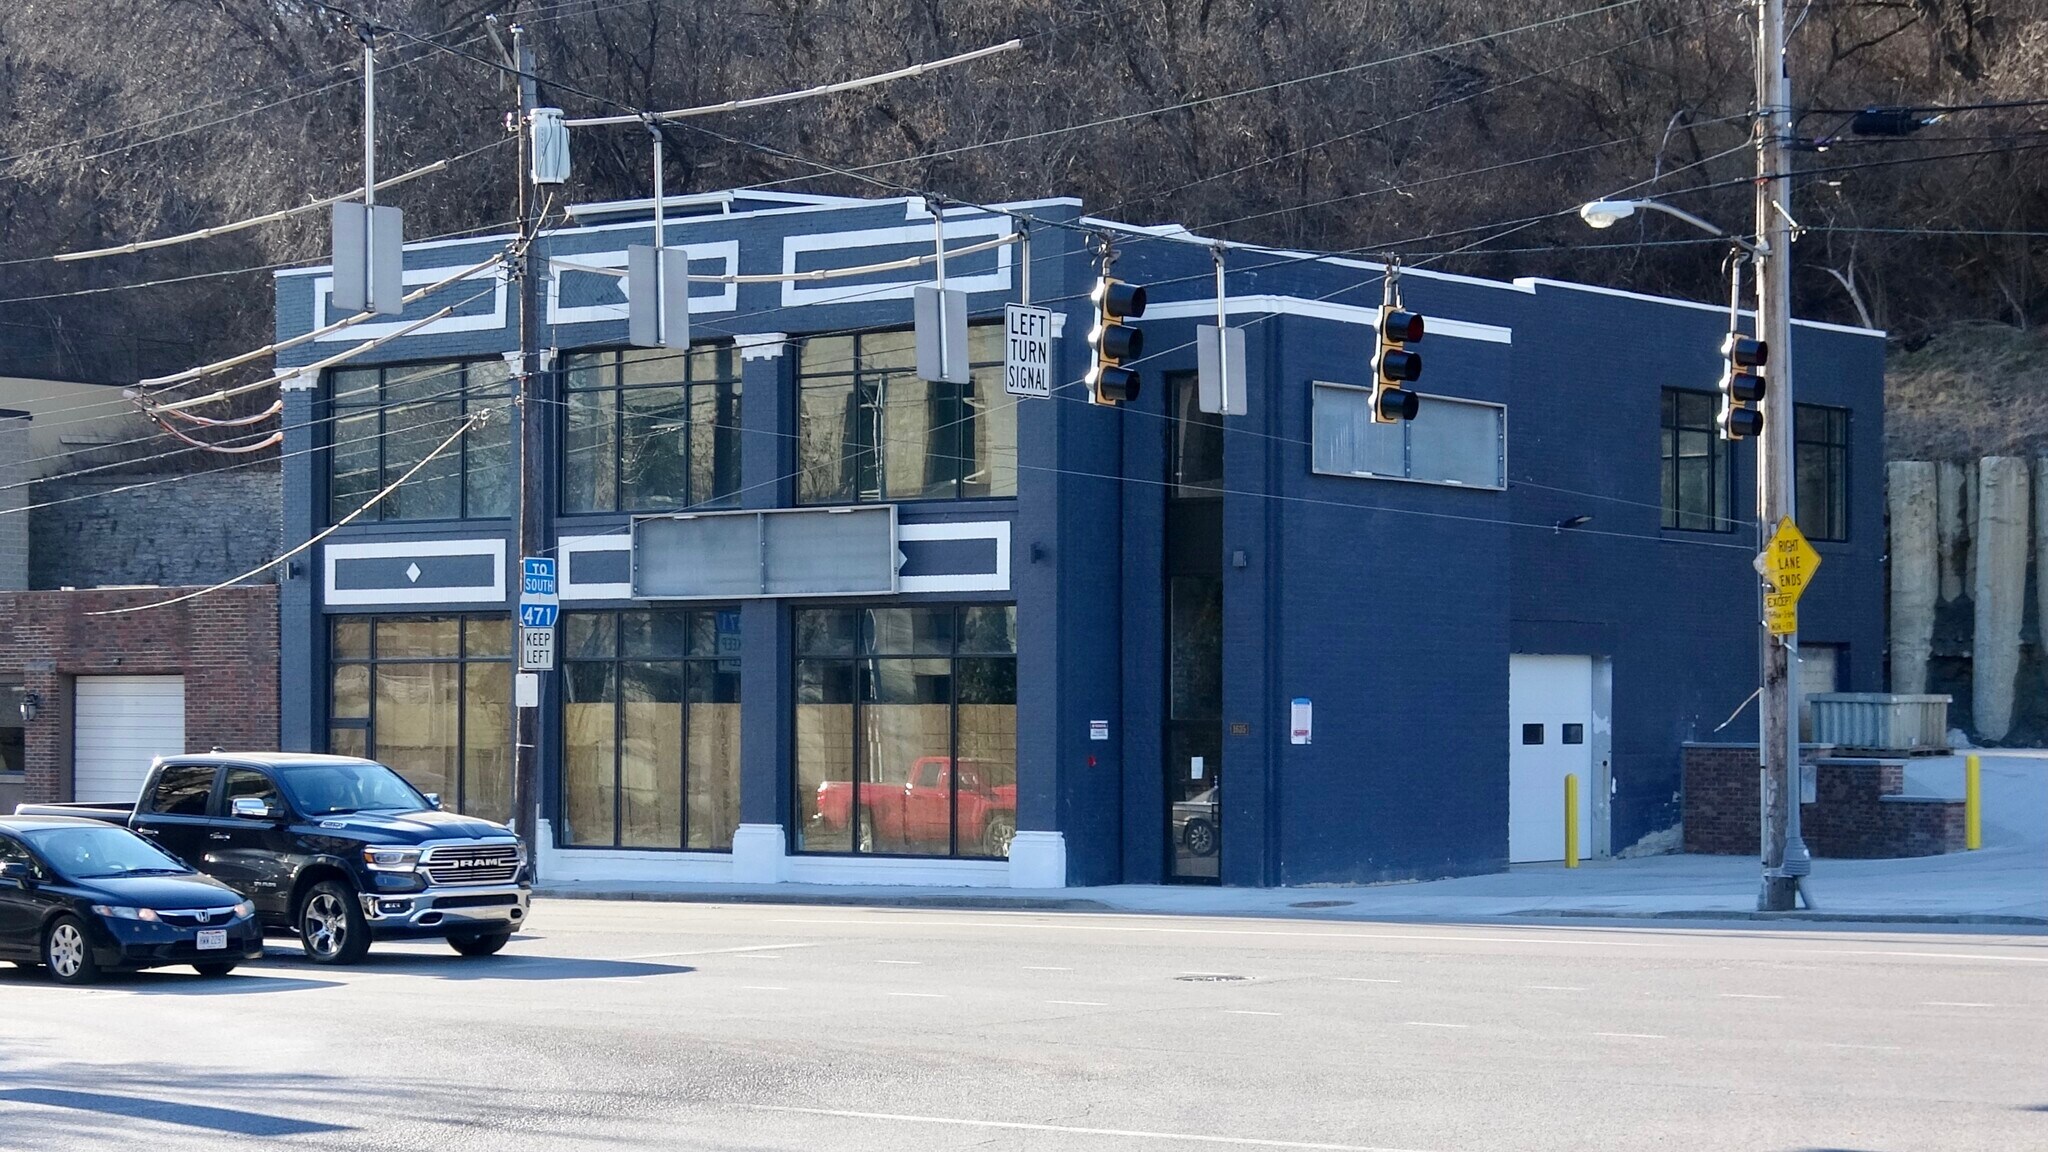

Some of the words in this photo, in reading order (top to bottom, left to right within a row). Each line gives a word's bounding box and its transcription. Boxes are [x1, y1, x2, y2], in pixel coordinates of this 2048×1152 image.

[1011, 312, 1046, 337] LEFT
[1011, 339, 1046, 364] TURN
[1009, 365, 1047, 390] SIGNAL
[1778, 539, 1799, 553] RIGHT
[532, 563, 548, 575] TO
[1778, 556, 1800, 570] LANE
[525, 578, 554, 592] SOUTH
[1780, 573, 1802, 587] ENDS
[1767, 595, 1792, 607] EXCEPT
[523, 606, 551, 625] 471
[526, 632, 550, 647] KEEP
[526, 650, 550, 664] LEFT
[460, 858, 498, 867] RAM
